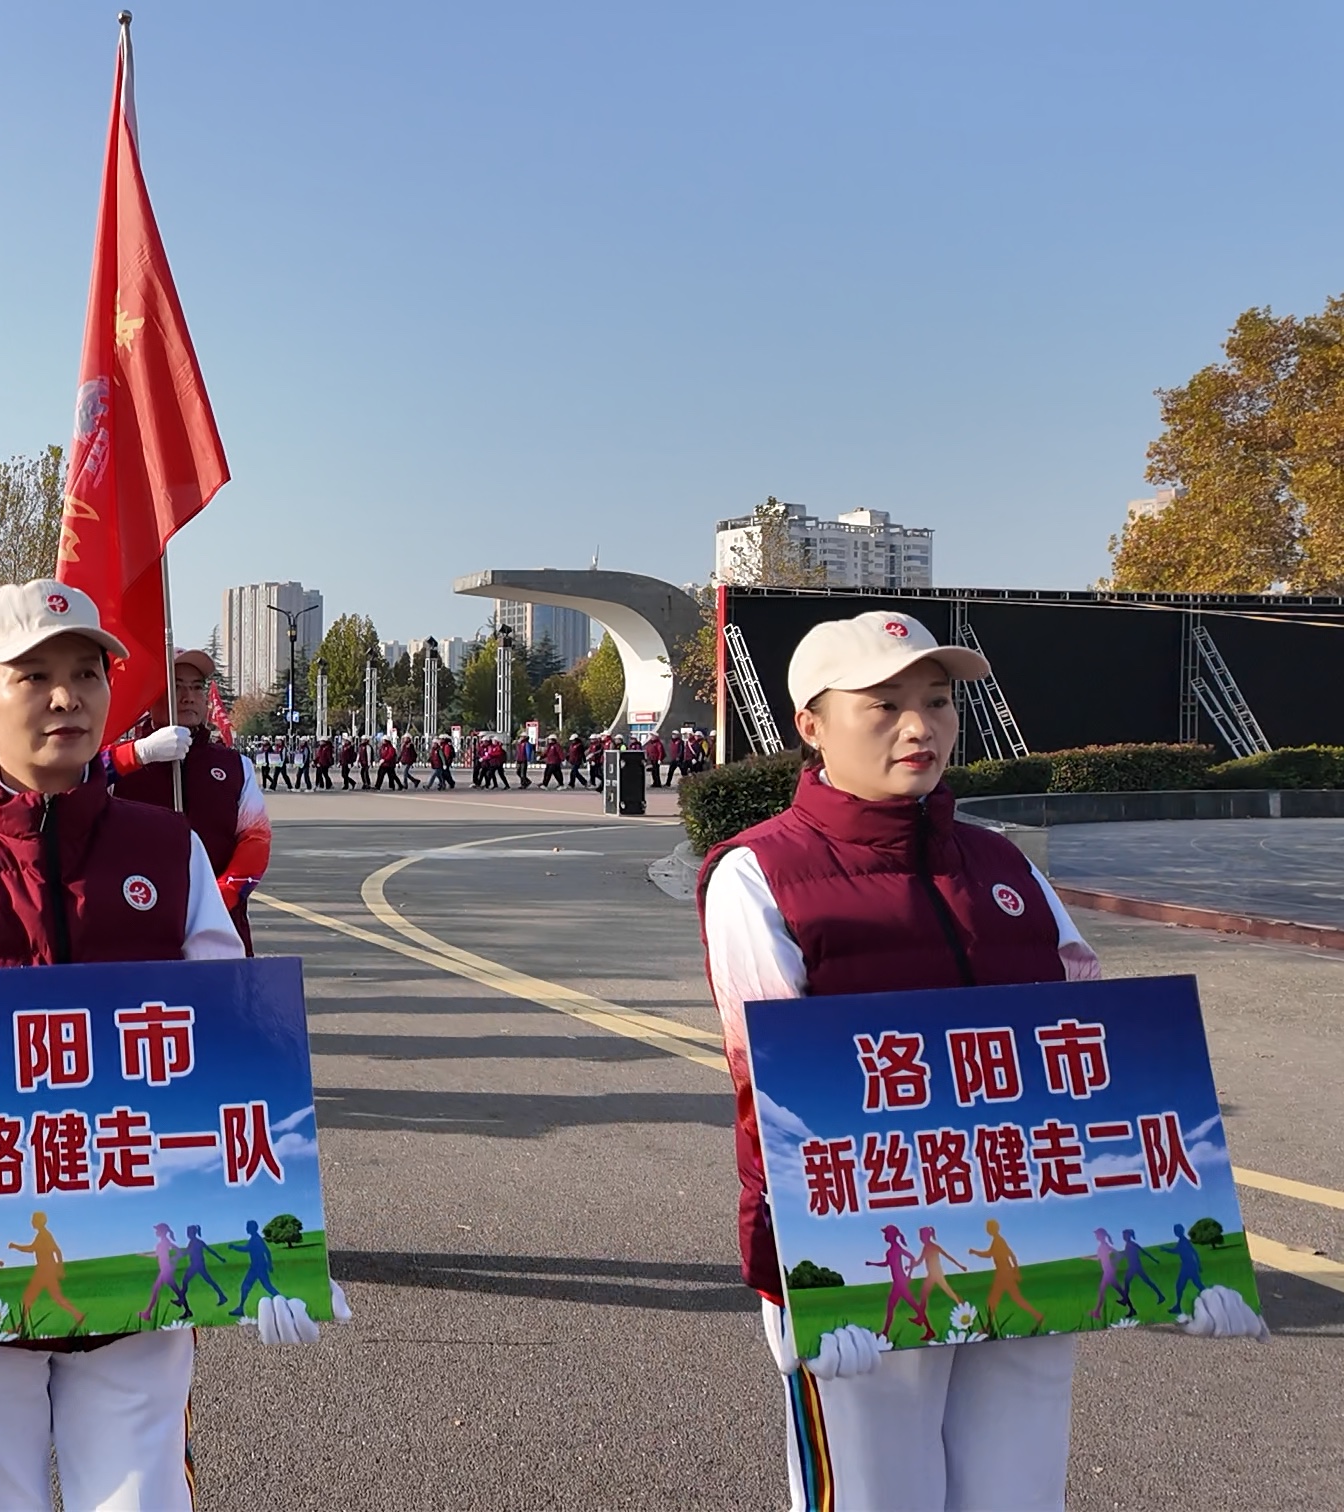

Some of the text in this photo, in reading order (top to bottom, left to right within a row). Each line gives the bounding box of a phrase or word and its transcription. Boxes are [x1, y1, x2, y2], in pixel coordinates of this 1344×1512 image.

[855, 1020, 1110, 1112] 洛阳市
[802, 1113, 1201, 1216] 新丝路健走二队
